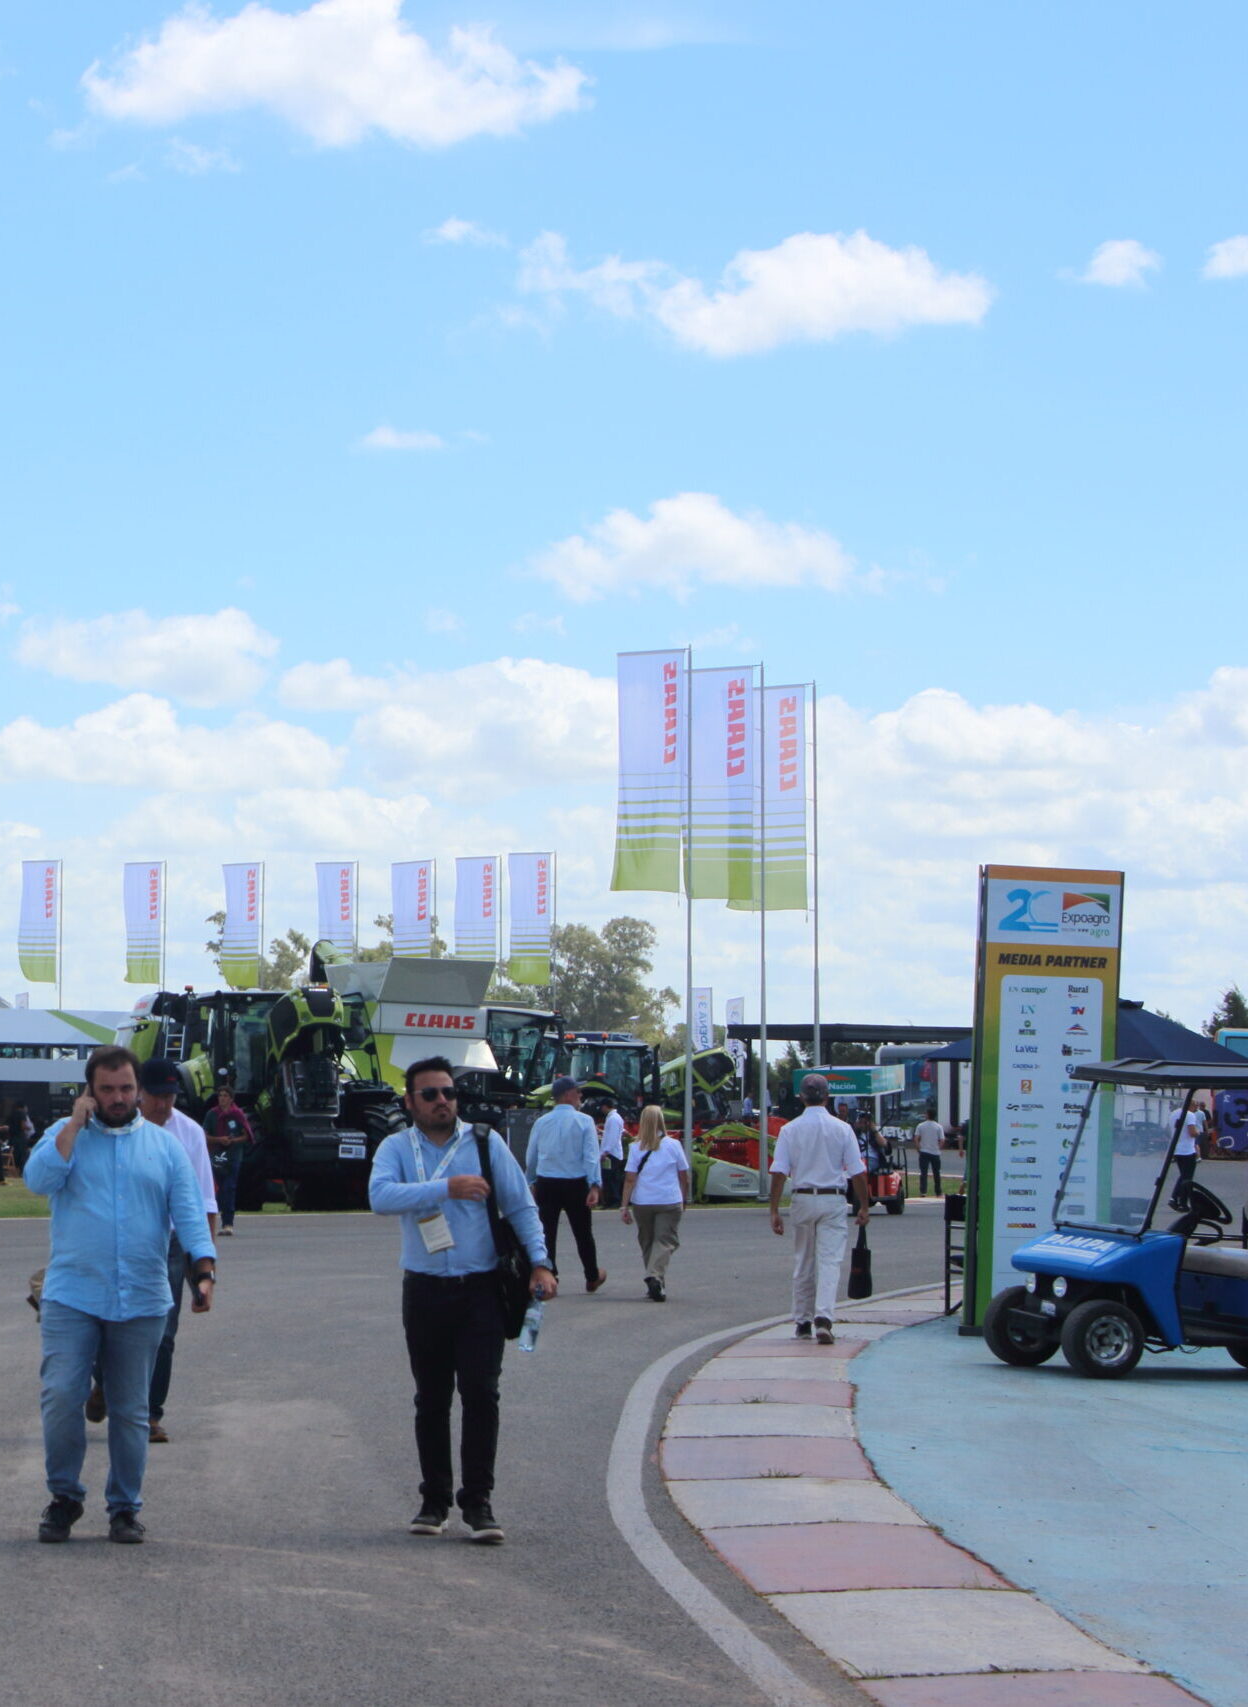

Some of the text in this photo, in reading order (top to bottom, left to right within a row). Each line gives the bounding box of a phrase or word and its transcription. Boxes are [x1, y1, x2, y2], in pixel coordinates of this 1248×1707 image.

[1062, 912, 1110, 926] Expoagro
[1090, 928, 1110, 938] agro
[998, 952, 1107, 968] MEDIA PARTNER
[1068, 985, 1089, 993] Rural
[405, 1013, 475, 1030] CLAAS
[828, 1082, 856, 1090] Nación
[1041, 1233, 1116, 1252] PAMPA
